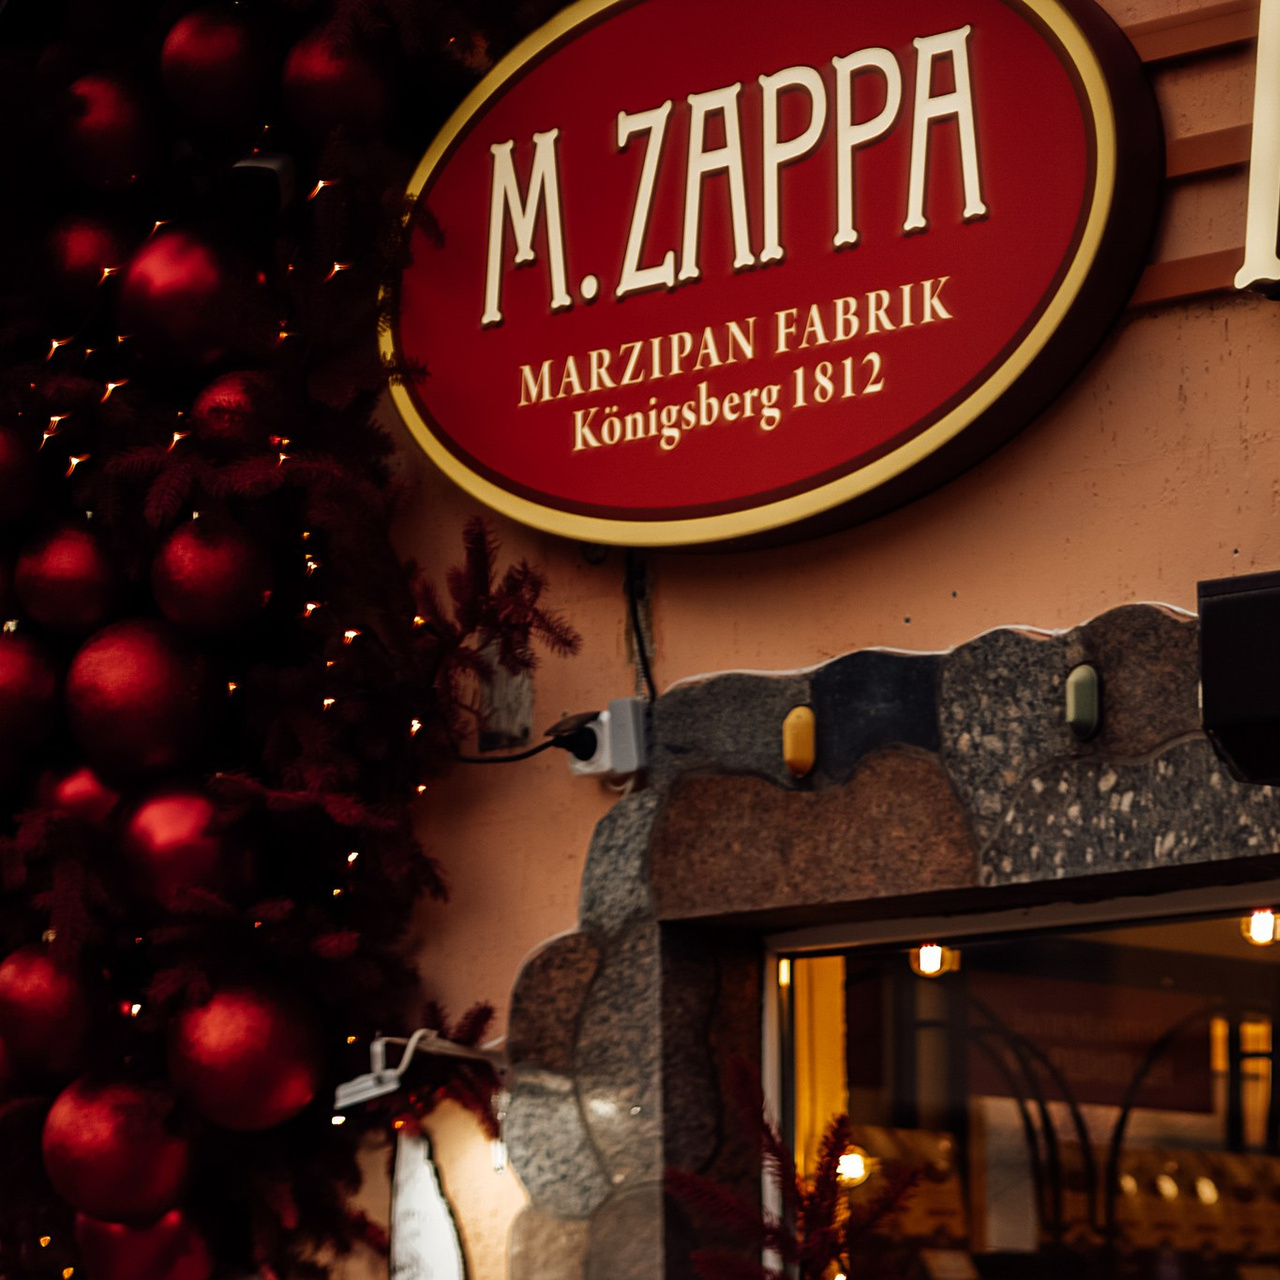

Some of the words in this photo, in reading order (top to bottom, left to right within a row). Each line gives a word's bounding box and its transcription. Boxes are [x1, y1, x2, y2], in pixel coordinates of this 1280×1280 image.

[481, 127, 600, 328] M.
[616, 24, 988, 299] ZAPPA
[518, 316, 757, 408] MARZIPAN
[775, 275, 953, 355] FABRIK
[571, 371, 782, 453] Königsberg
[792, 351, 886, 410] 1812
